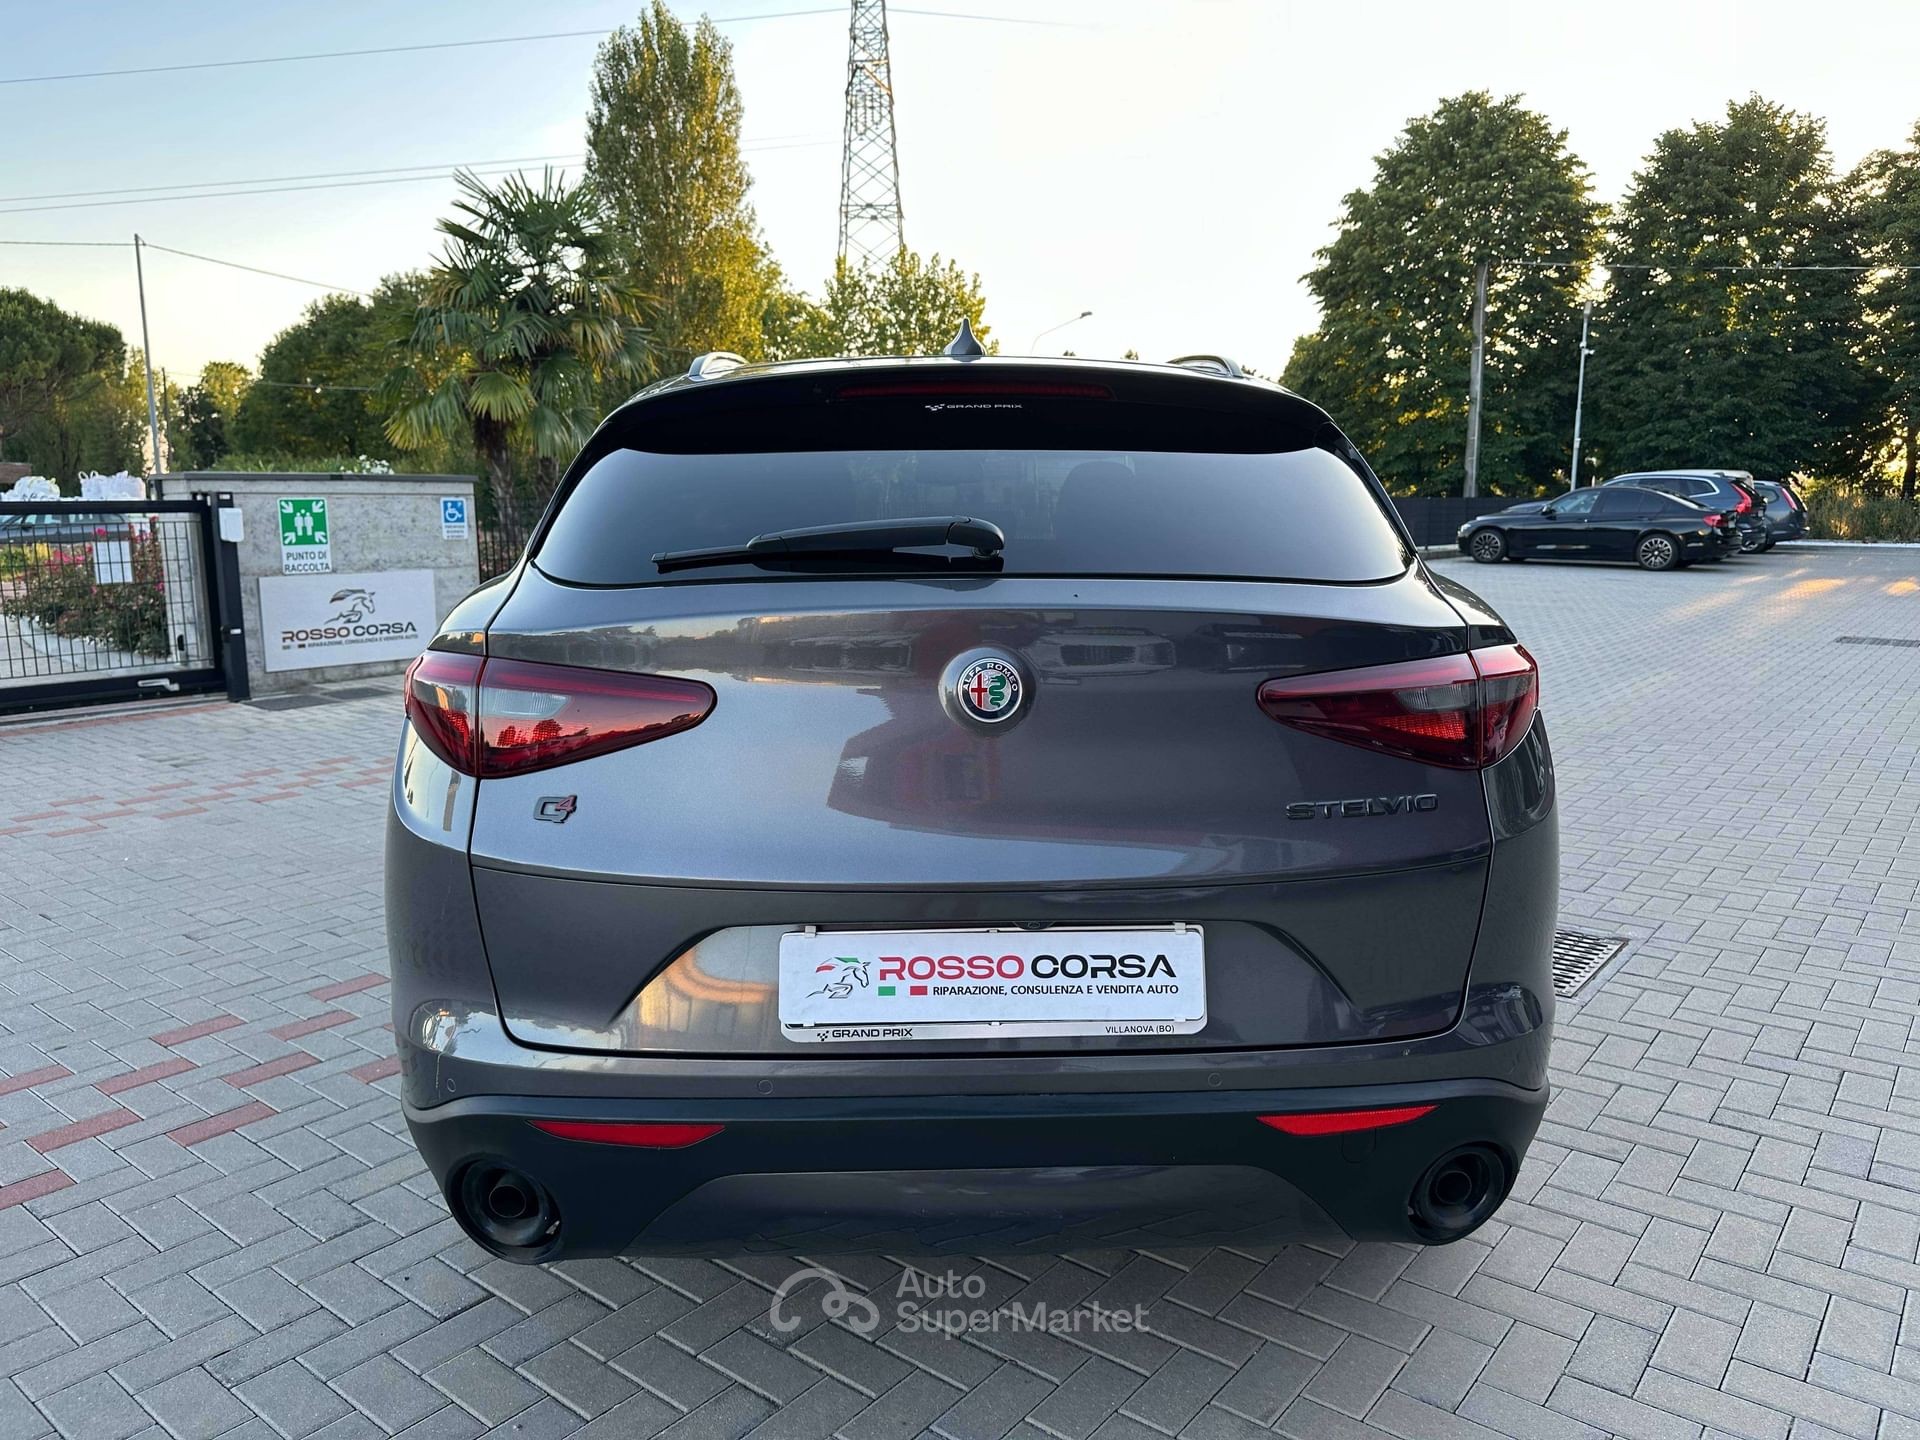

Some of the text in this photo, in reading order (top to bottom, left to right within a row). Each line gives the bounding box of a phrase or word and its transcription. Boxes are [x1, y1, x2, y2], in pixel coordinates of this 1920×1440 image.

[286, 551, 327, 561] PUNTO DI
[284, 563, 330, 572] RACCOLTA
[281, 621, 417, 643] ROSSO CORSA
[963, 662, 1018, 692] ALFA ROMEO
[1286, 793, 1439, 820] STELVIO
[878, 954, 1177, 981] ROSSO CORSA
[933, 984, 1179, 996] RIPARAZIONE, CONSULENZA E VENDITA AUTO
[832, 1028, 913, 1038] GRAND PRIX
[1105, 1024, 1175, 1034] VILLANOVA (BO)
